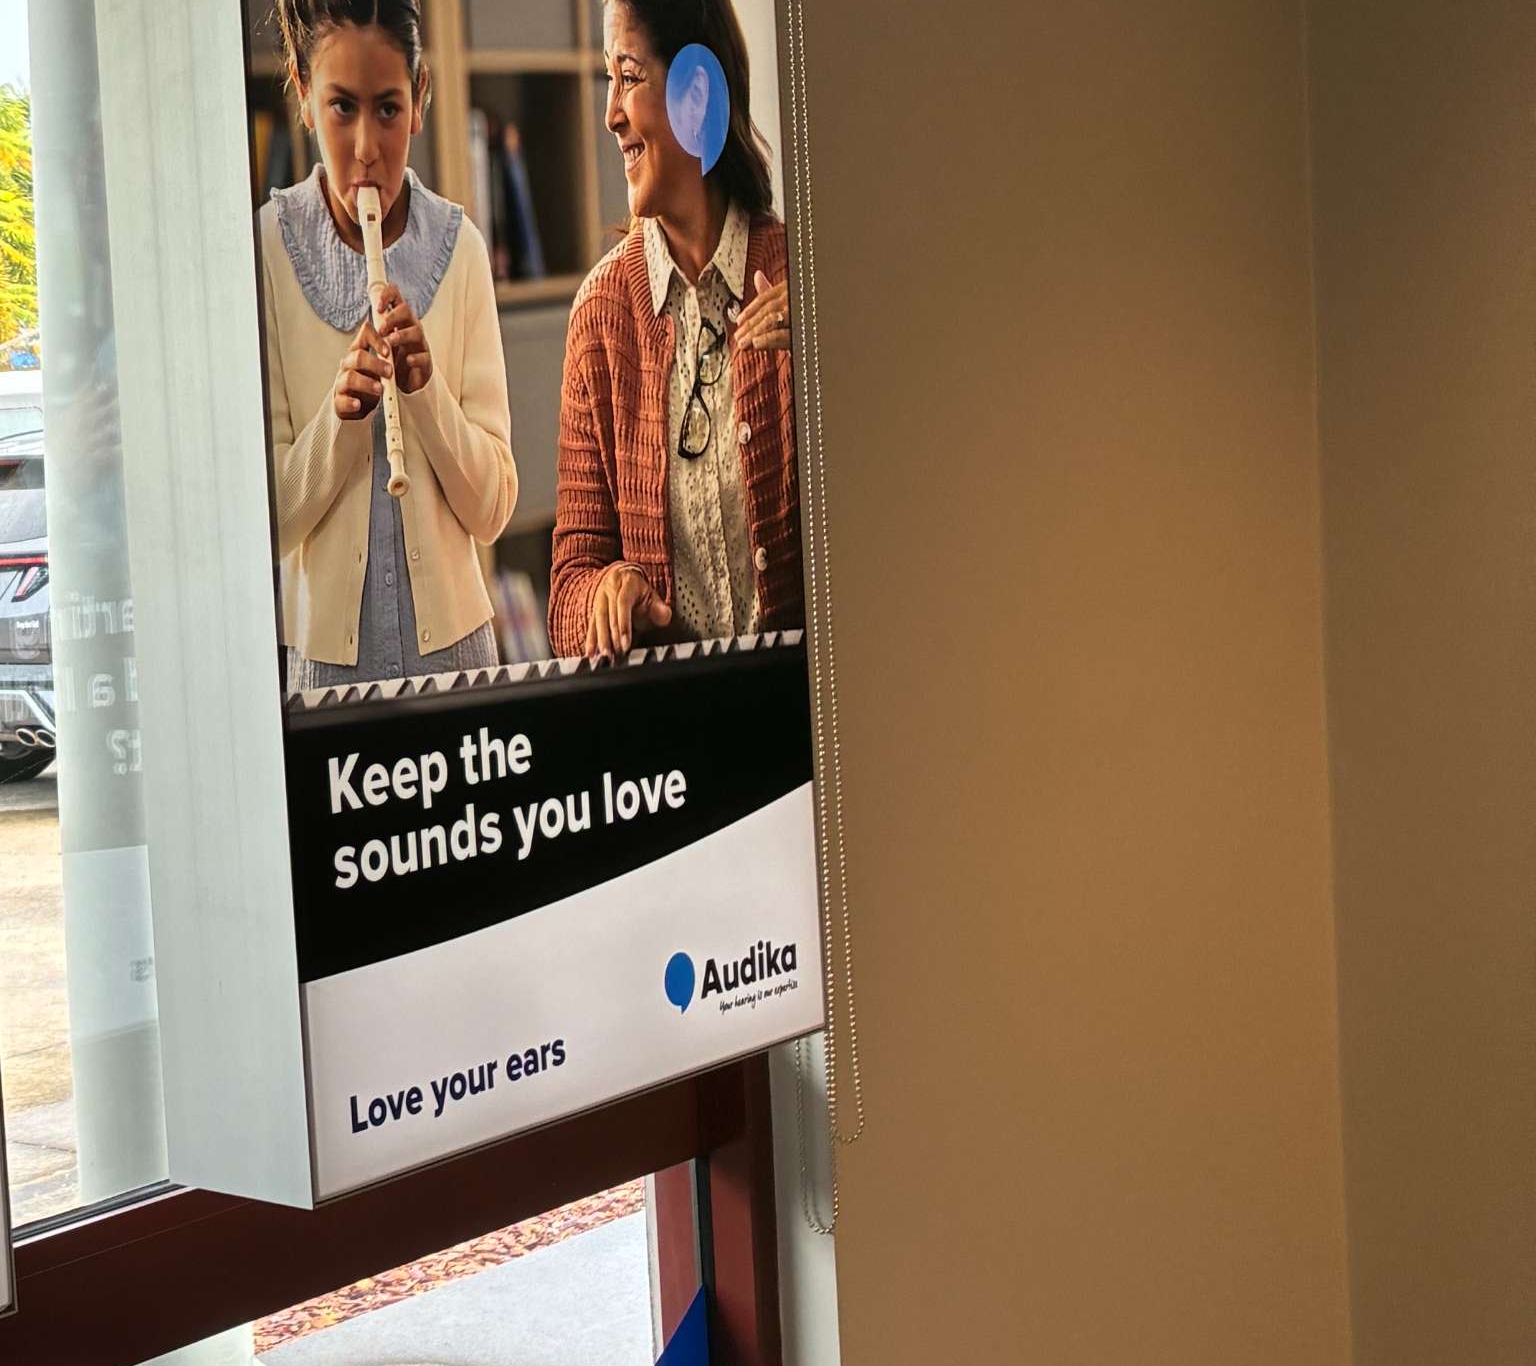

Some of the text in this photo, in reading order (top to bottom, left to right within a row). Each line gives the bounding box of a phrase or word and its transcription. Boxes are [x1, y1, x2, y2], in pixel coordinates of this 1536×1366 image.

[328, 727, 532, 814] Keep the
[334, 769, 687, 889] sounds you love
[700, 939, 797, 1000] Audika
[734, 993, 756, 1009] hearing
[349, 1039, 566, 1134] Love your ears
